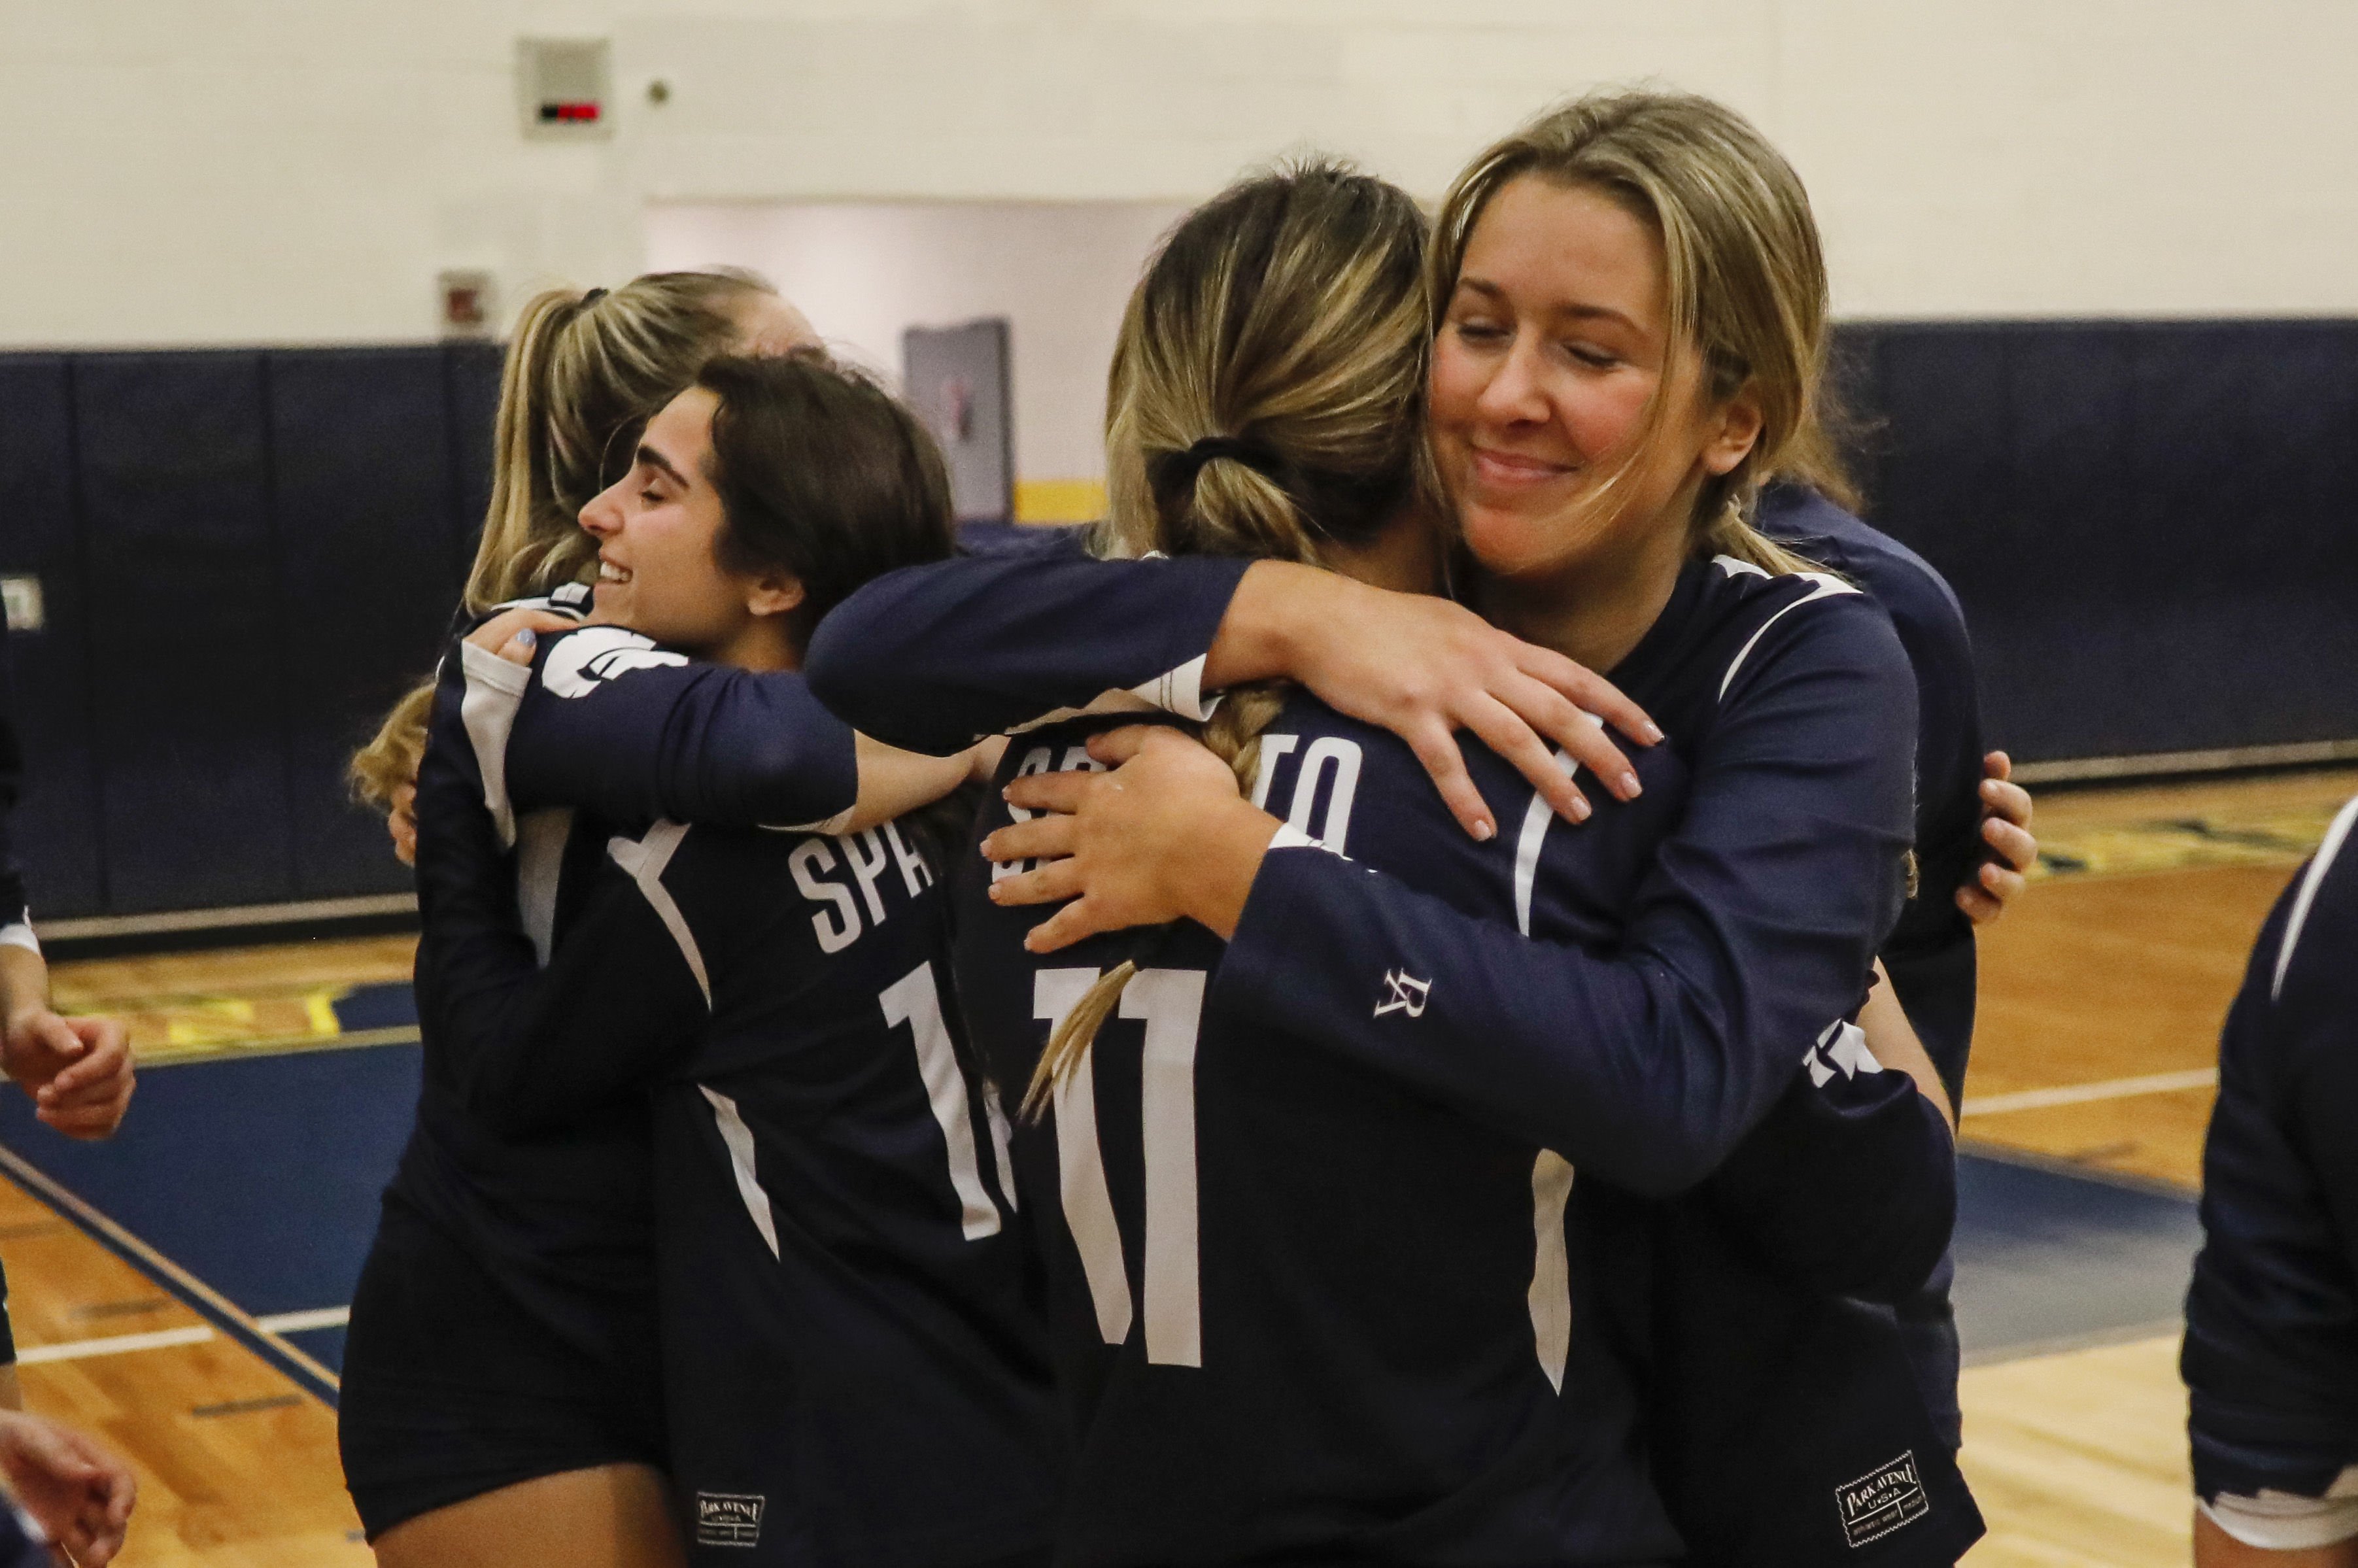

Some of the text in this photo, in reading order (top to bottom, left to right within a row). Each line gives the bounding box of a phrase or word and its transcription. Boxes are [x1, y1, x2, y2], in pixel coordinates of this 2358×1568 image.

[1033, 967, 1207, 1368] 11
[1847, 1482, 1876, 1517] PARK
[1877, 1463, 1917, 1491] AVENUE
